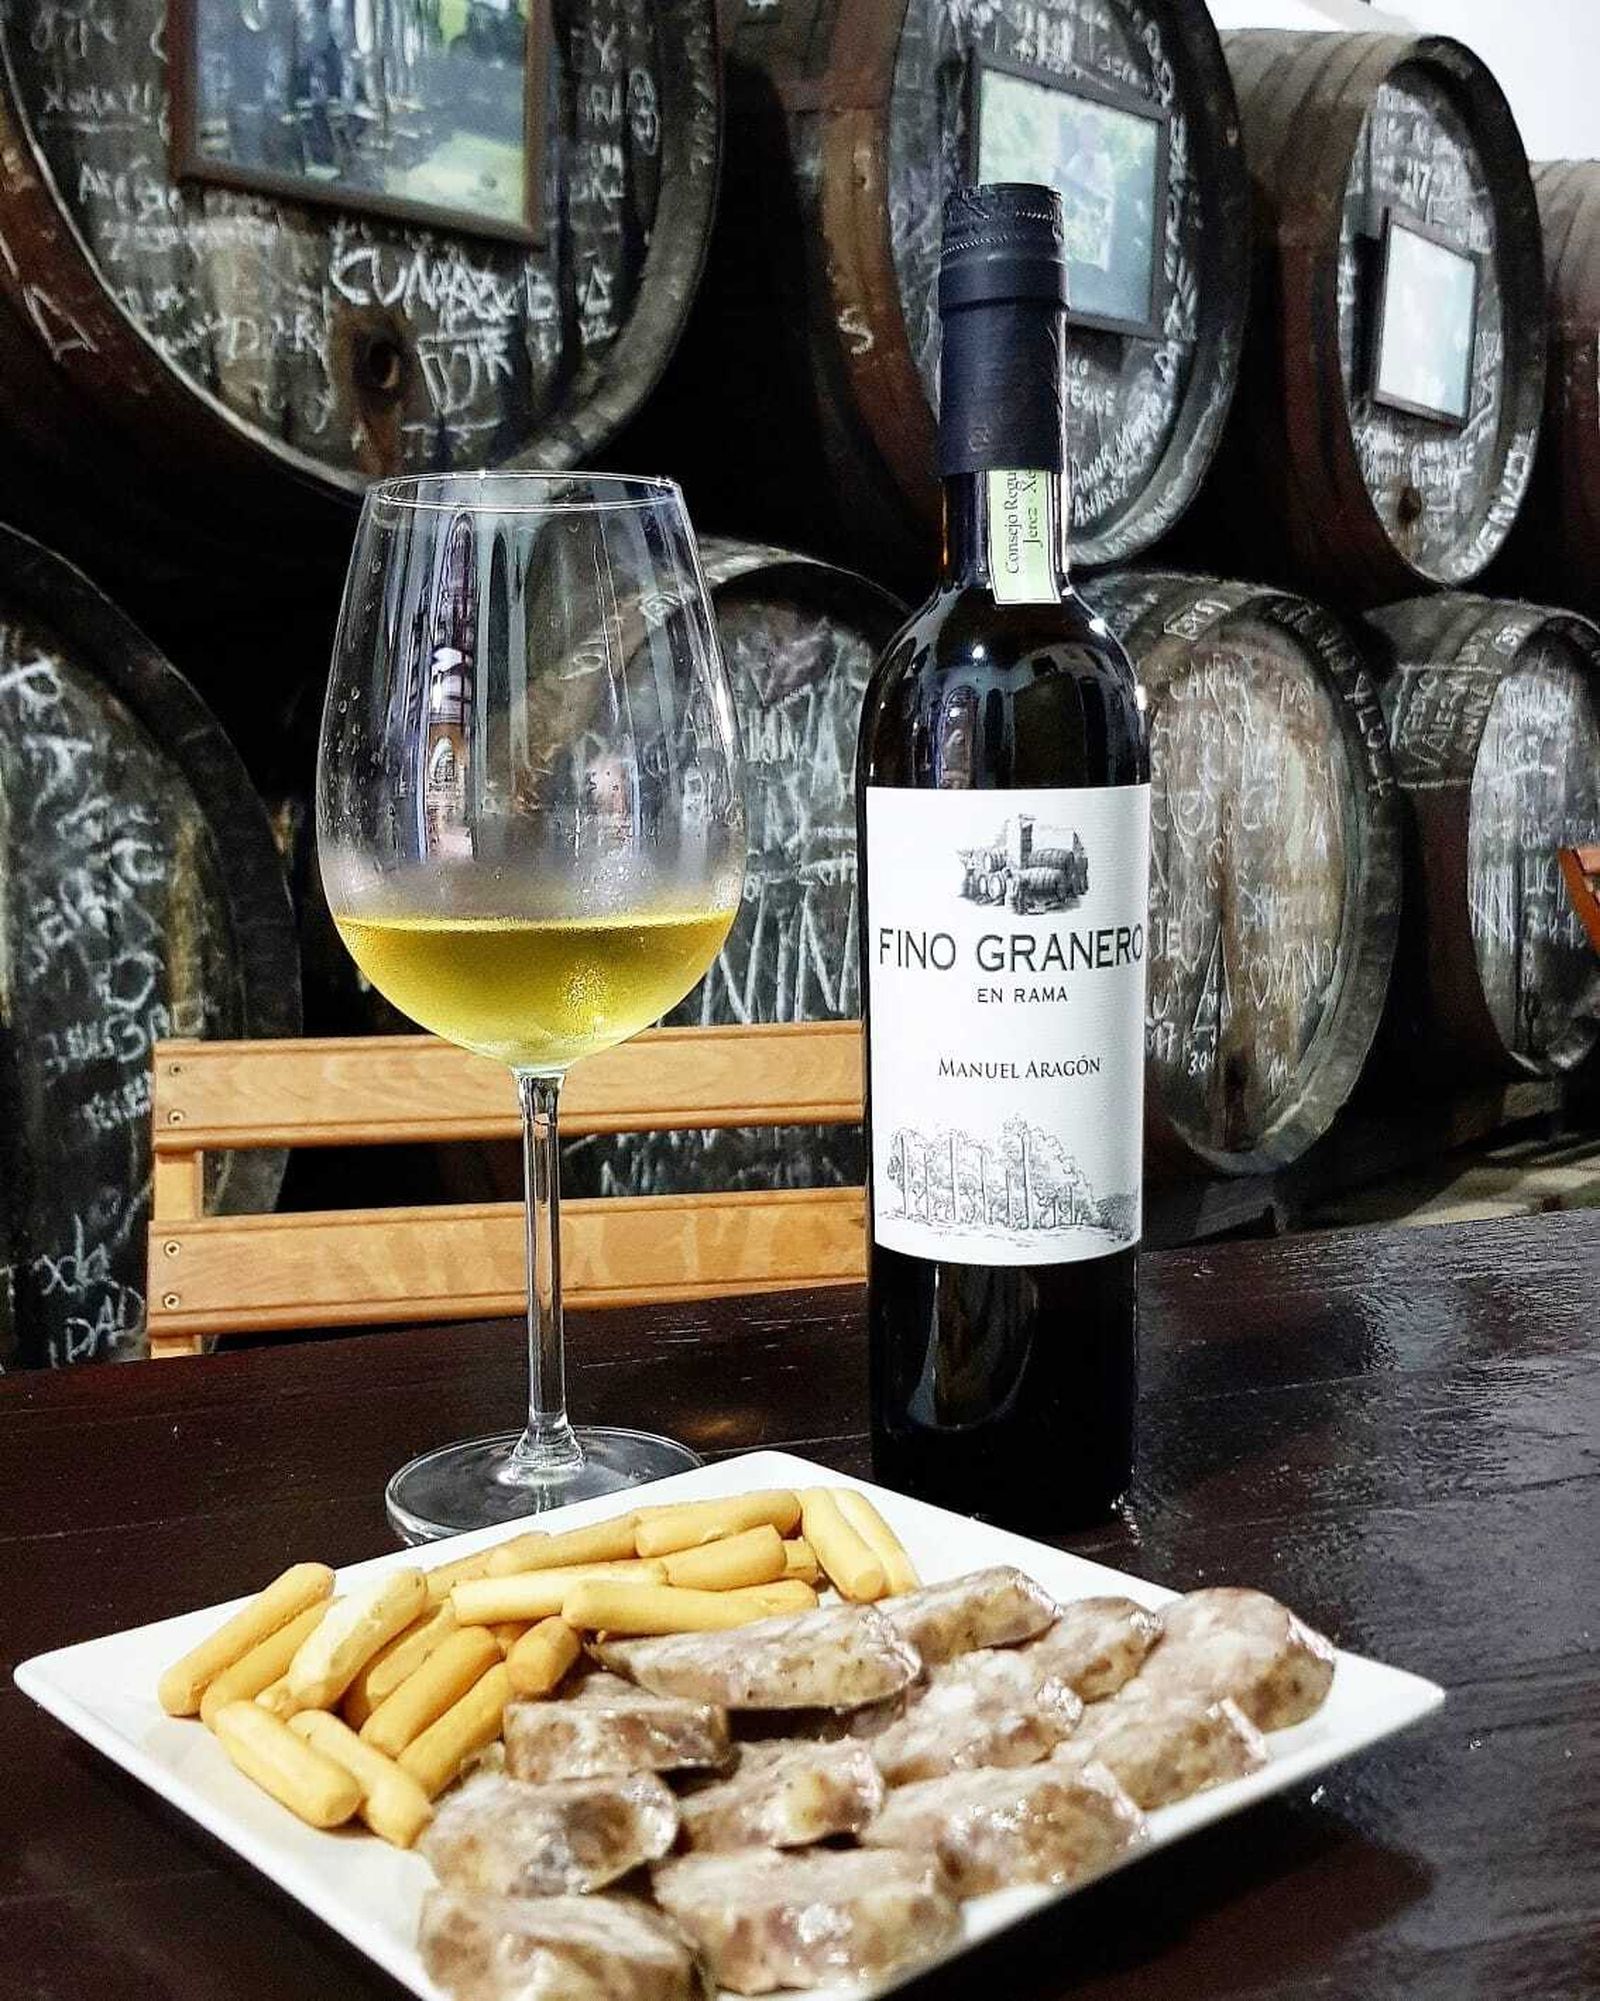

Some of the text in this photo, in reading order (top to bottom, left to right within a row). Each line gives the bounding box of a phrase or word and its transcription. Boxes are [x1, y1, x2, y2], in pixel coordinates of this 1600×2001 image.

[1004, 513, 1022, 575] Consejo
[1023, 507, 1043, 549] Jerez
[879, 928, 957, 971] FINO
[976, 923, 1144, 972] GRANERO
[977, 986, 1069, 1003] EN RAMA
[938, 1055, 1101, 1079] MANUEL ARAGÓN
